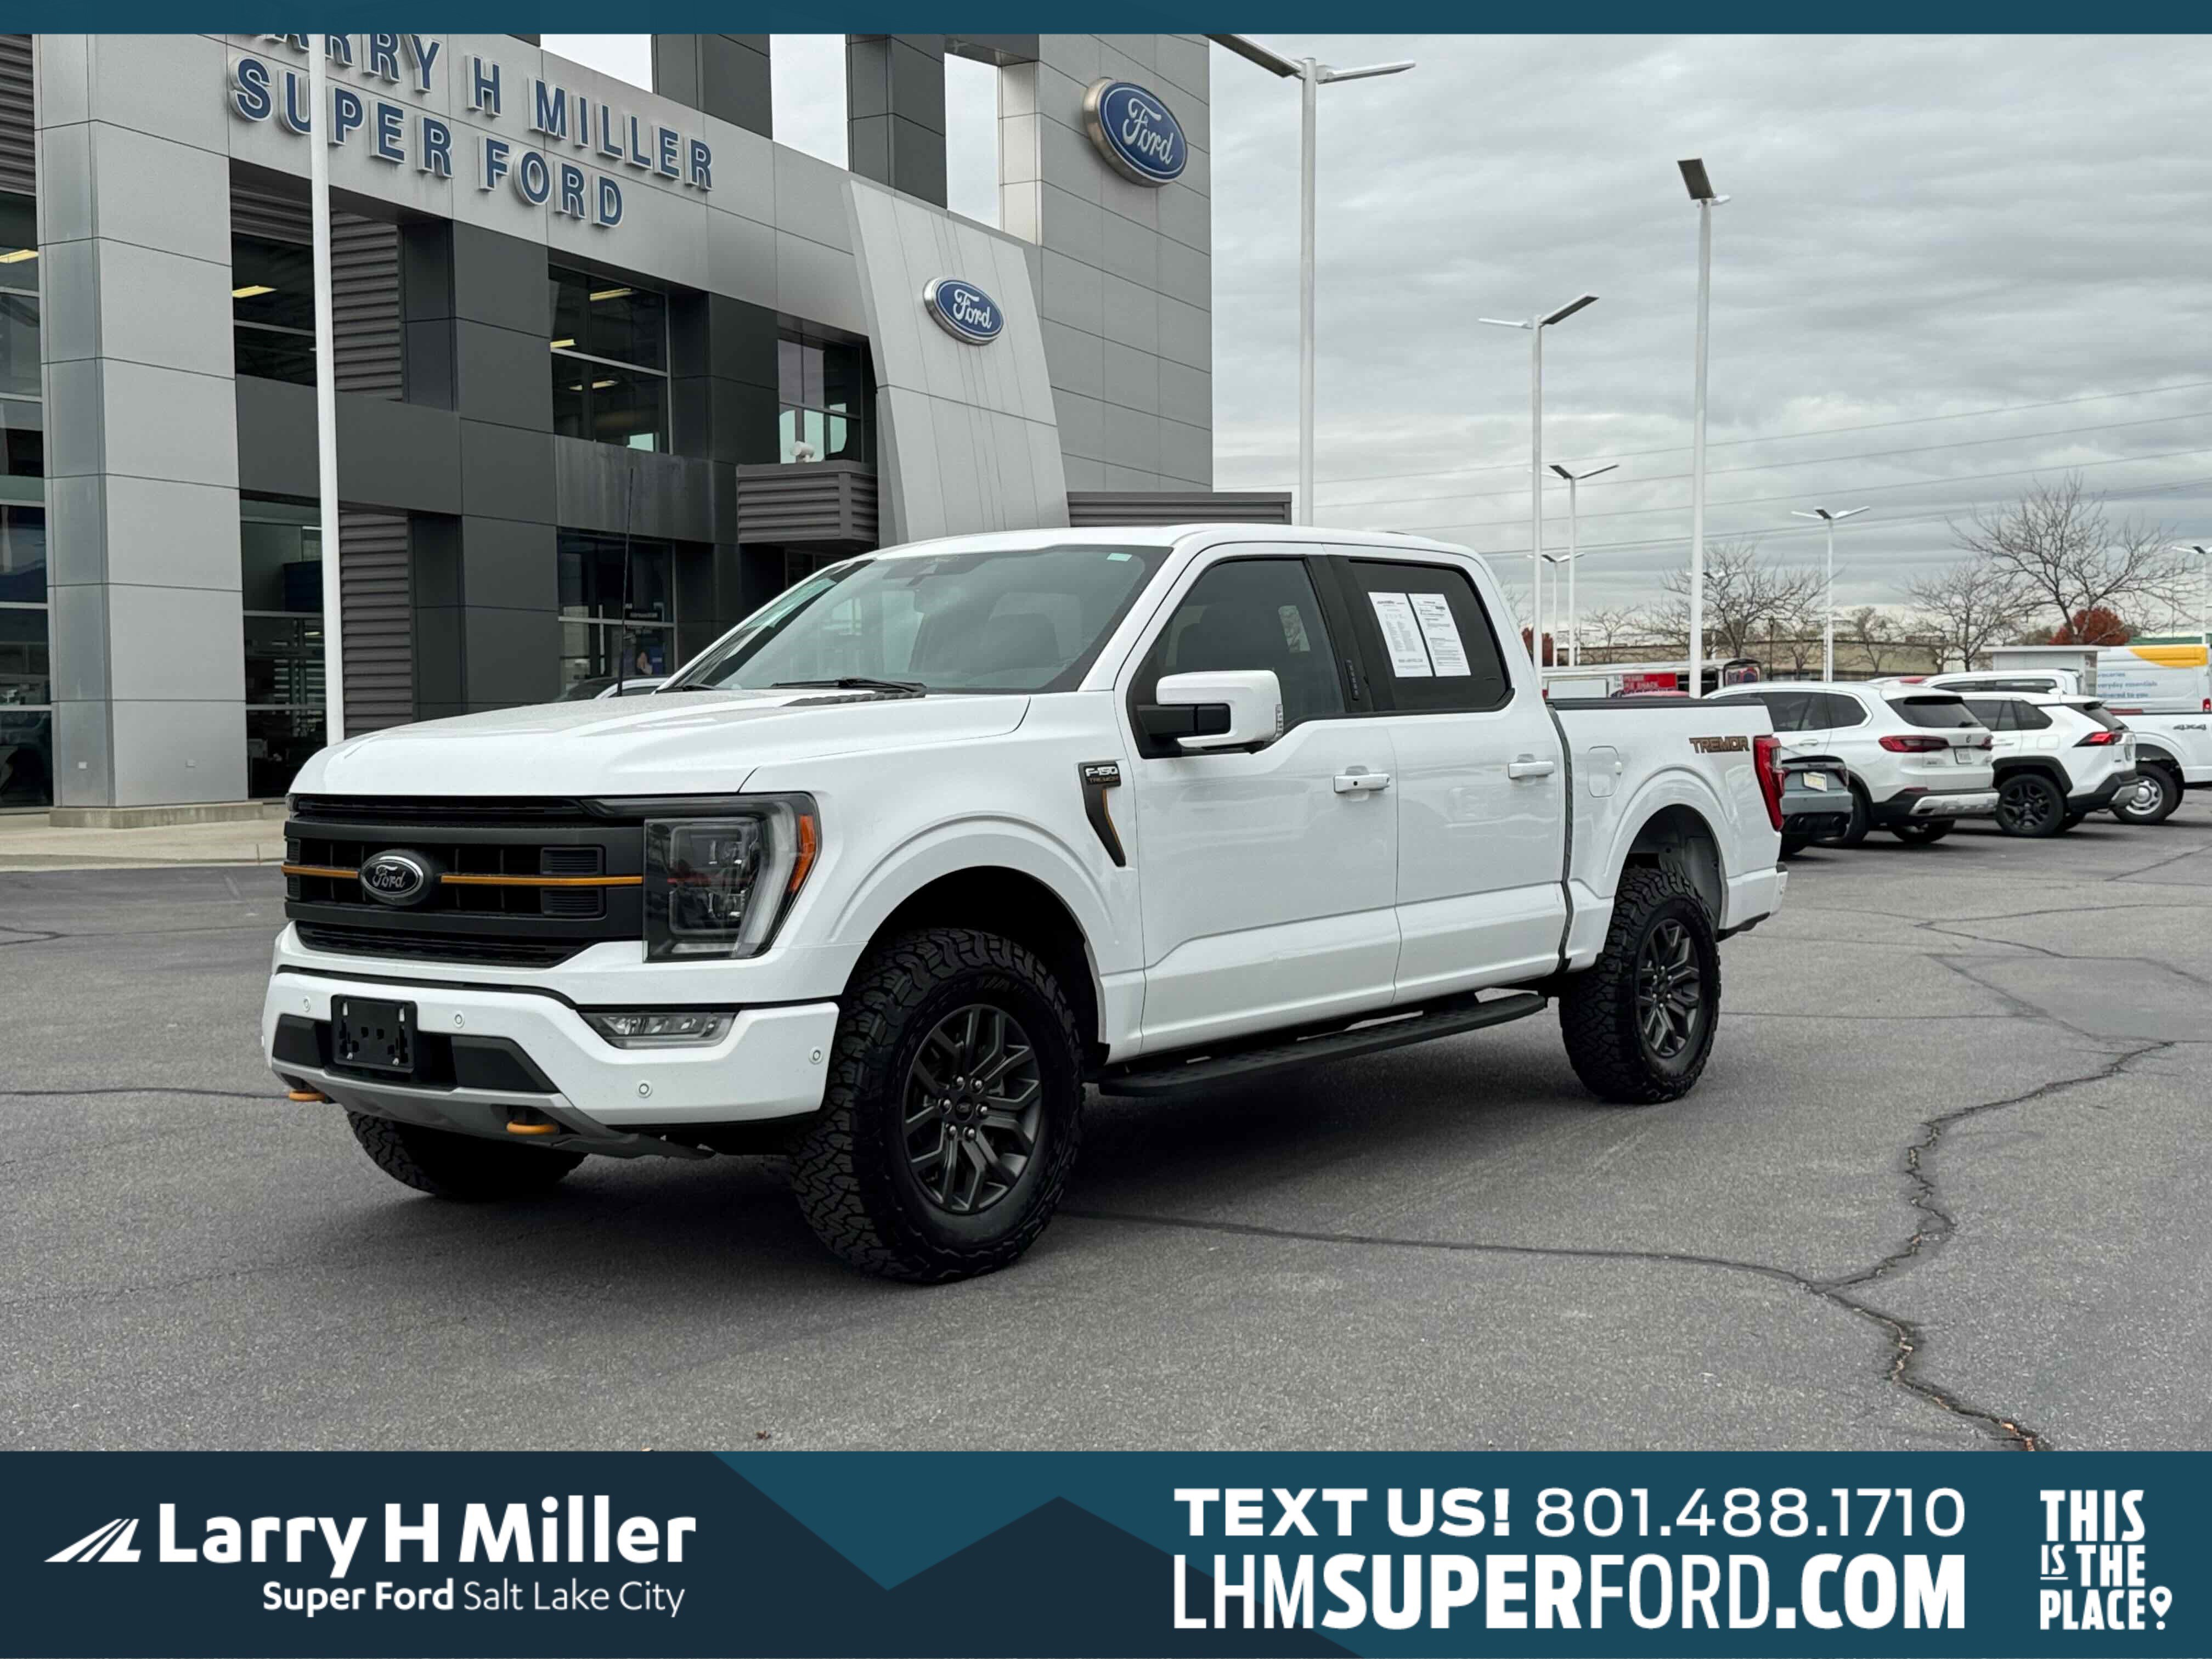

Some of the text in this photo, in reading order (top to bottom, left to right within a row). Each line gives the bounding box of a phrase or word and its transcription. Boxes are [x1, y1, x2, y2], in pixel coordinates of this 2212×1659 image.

[229, 55, 624, 228] SUPER FORD
[466, 55, 502, 117] H
[528, 76, 714, 191] MILLER
[1122, 97, 1173, 165] Ford
[953, 289, 992, 328] Ford
[1689, 736, 1750, 753] TREMOR
[1085, 766, 1119, 777] F-150
[372, 864, 407, 888] Ford
